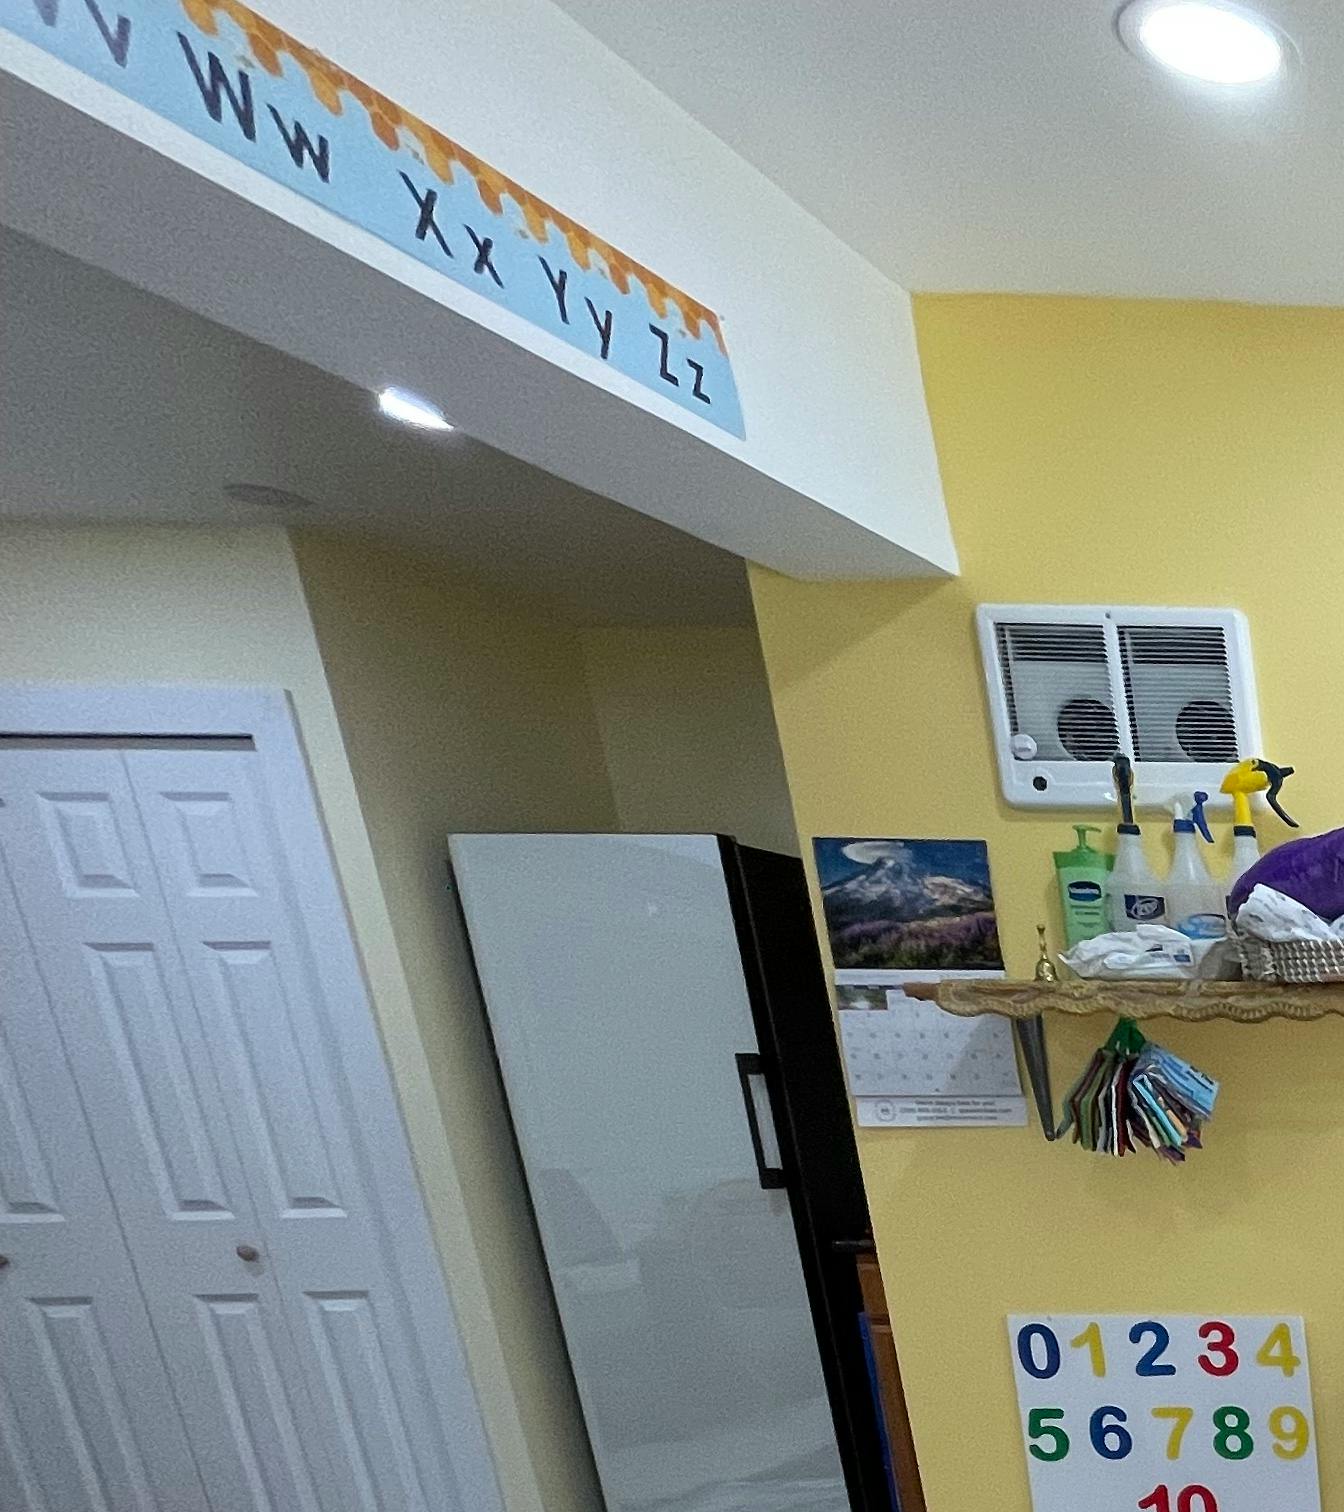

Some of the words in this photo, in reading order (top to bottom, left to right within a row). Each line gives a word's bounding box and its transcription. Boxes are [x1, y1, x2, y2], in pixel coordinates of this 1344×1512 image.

[1017, 1323, 1061, 1379] 0
[1070, 1321, 1107, 1378] 1
[1128, 1320, 1177, 1377] 2
[1197, 1320, 1240, 1377] 3
[1256, 1322, 1301, 1378] 4
[1028, 1407, 1070, 1462] 5
[1089, 1405, 1134, 1461] 6
[1151, 1406, 1194, 1461] 7
[1212, 1405, 1254, 1461] 8
[1268, 1405, 1310, 1461] 9
